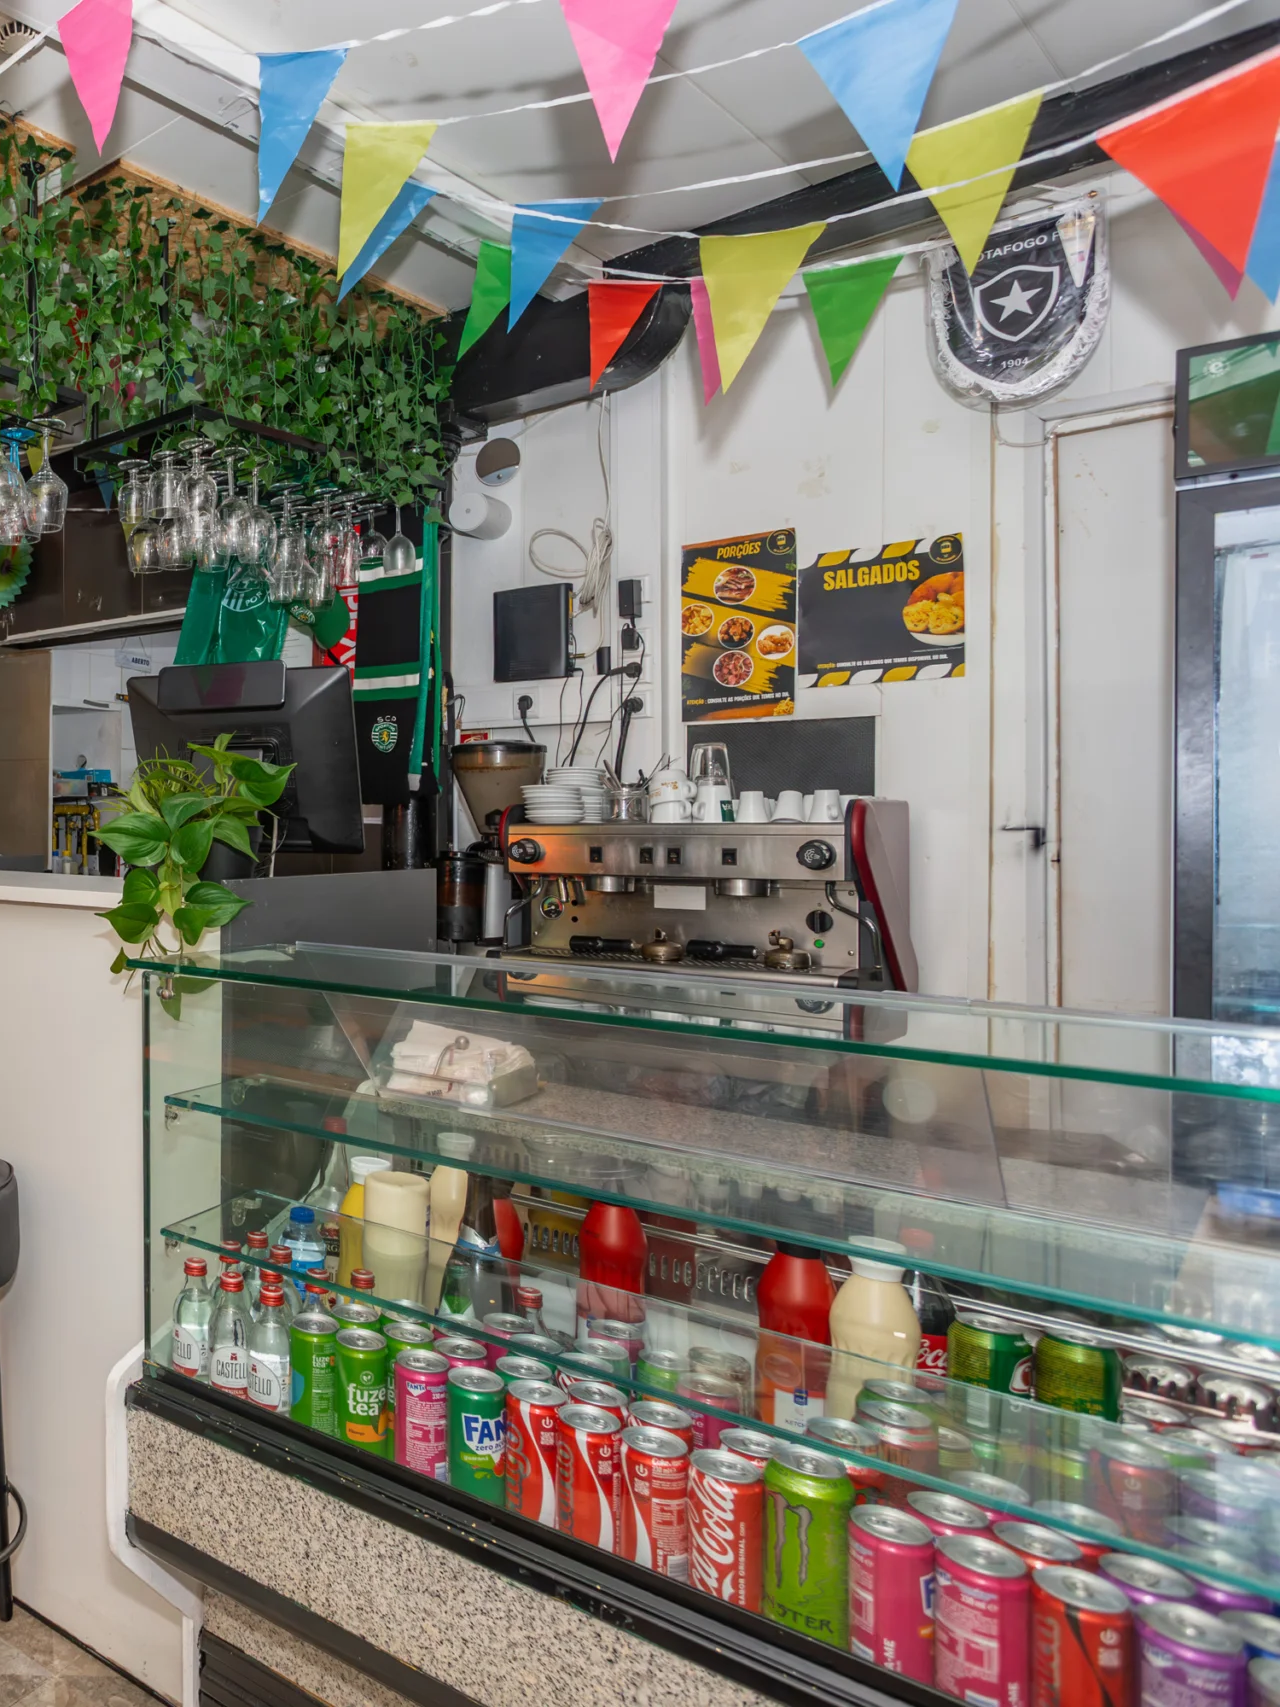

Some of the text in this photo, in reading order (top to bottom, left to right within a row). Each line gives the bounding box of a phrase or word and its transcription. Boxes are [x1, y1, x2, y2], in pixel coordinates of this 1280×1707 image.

[977, 234, 1048, 262] OTAFOGO
[1001, 356, 1029, 369] 1904
[716, 540, 762, 560] PORÇÕES
[823, 559, 920, 591] SALGADOS
[131, 656, 150, 667] ABERTO
[216, 1359, 247, 1380] CASTELL
[347, 1383, 387, 1403] fuze
[347, 1399, 380, 1416] tea
[463, 1409, 507, 1444] FAN
[738, 1539, 746, 1576] ORIGINAL
